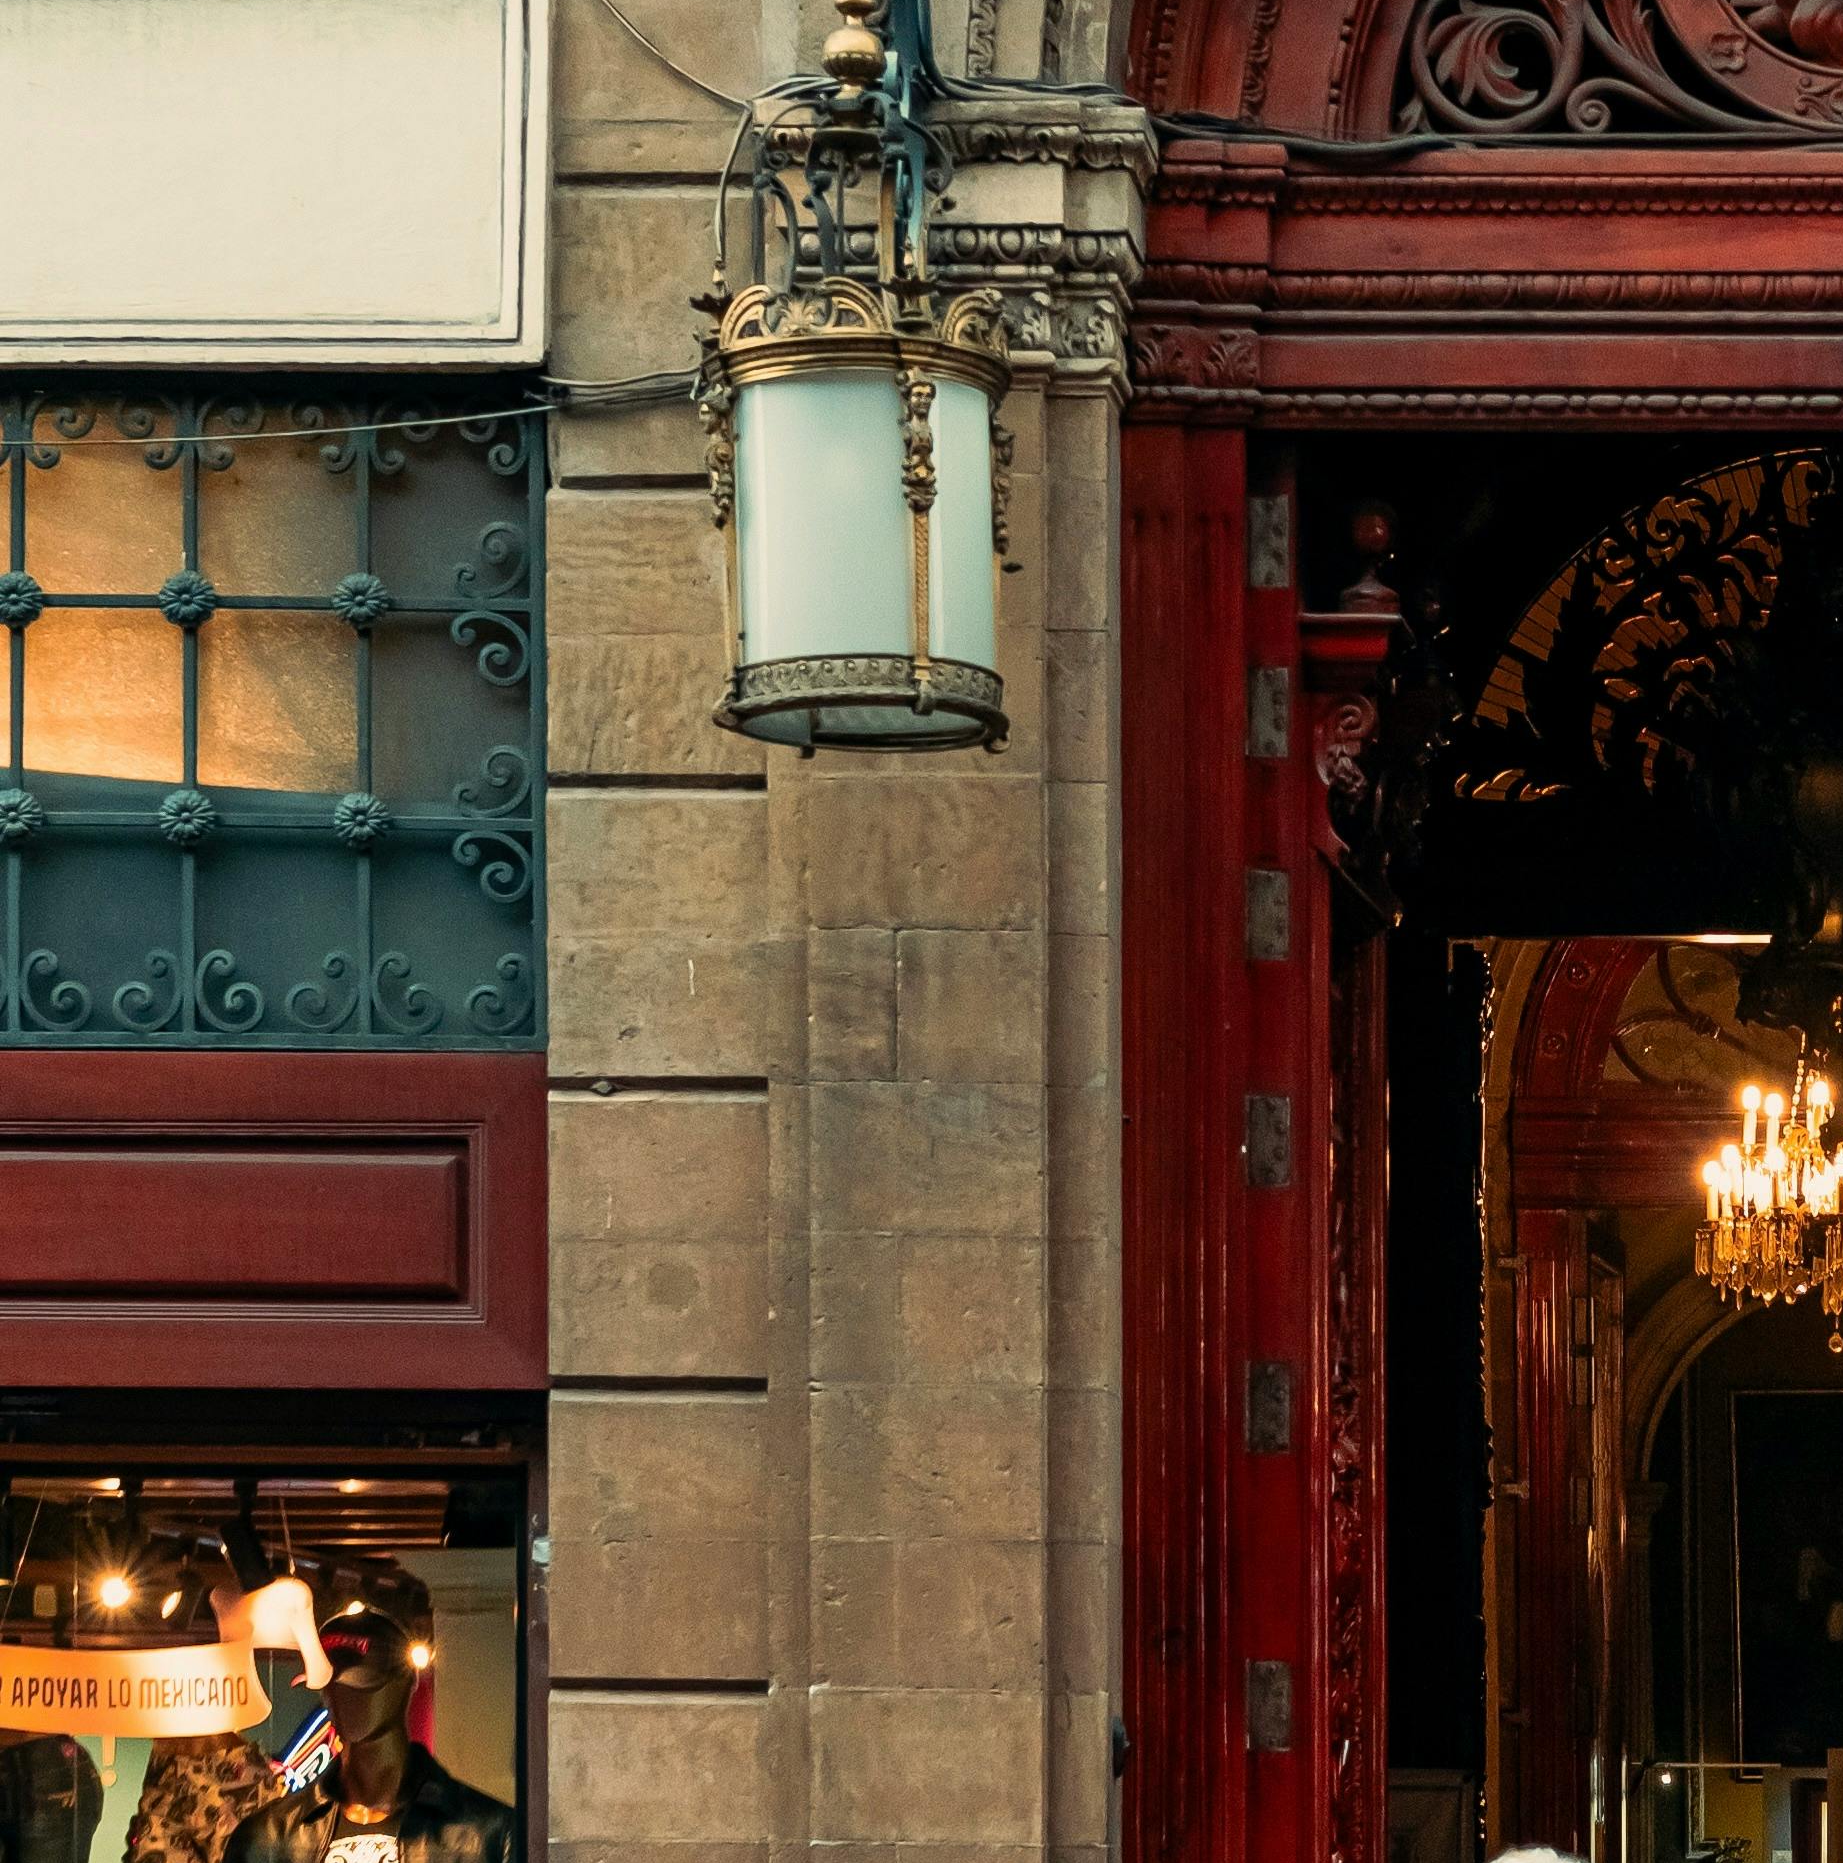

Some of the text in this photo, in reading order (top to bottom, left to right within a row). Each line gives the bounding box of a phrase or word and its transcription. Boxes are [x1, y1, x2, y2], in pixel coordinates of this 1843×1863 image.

[12, 1675, 249, 1710] APOYAR LO MEXICANO
